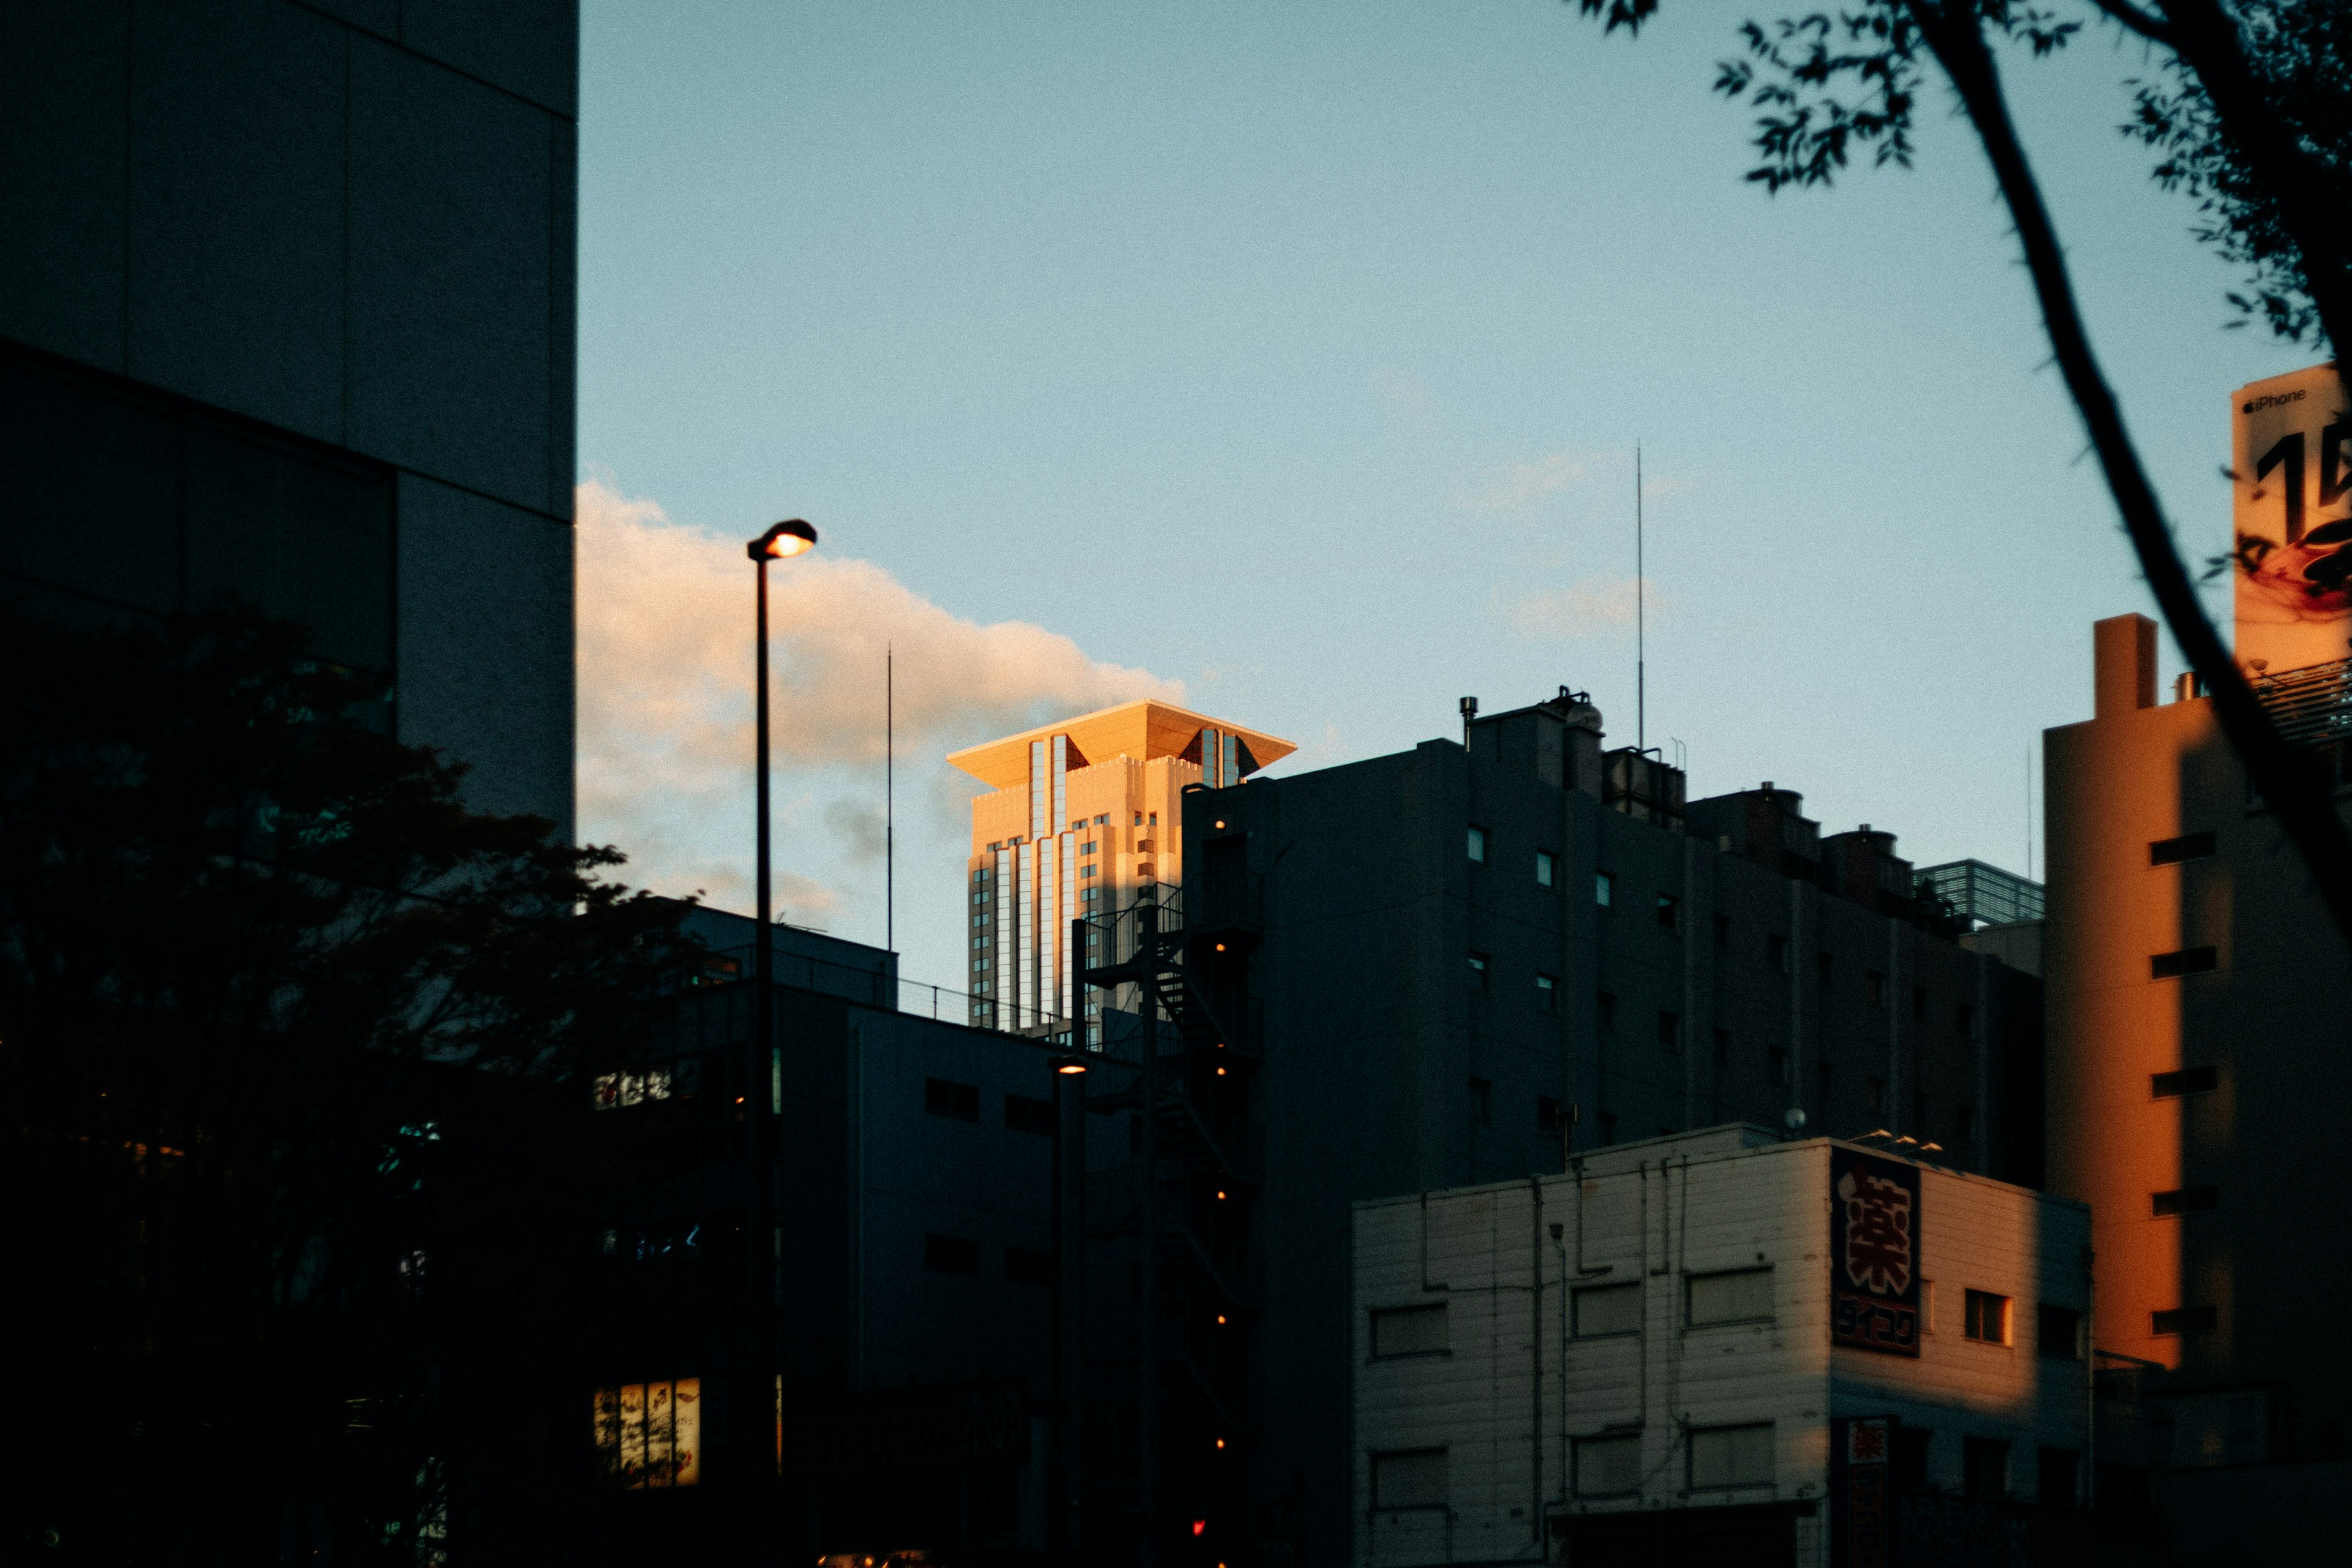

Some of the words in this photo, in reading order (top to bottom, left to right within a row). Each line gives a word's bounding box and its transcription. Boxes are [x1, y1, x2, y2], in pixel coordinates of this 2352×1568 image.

[2255, 390, 2306, 411] iPhone
[1842, 1163, 1910, 1291] 薬
[1838, 1298, 1915, 1345] ダイコク
